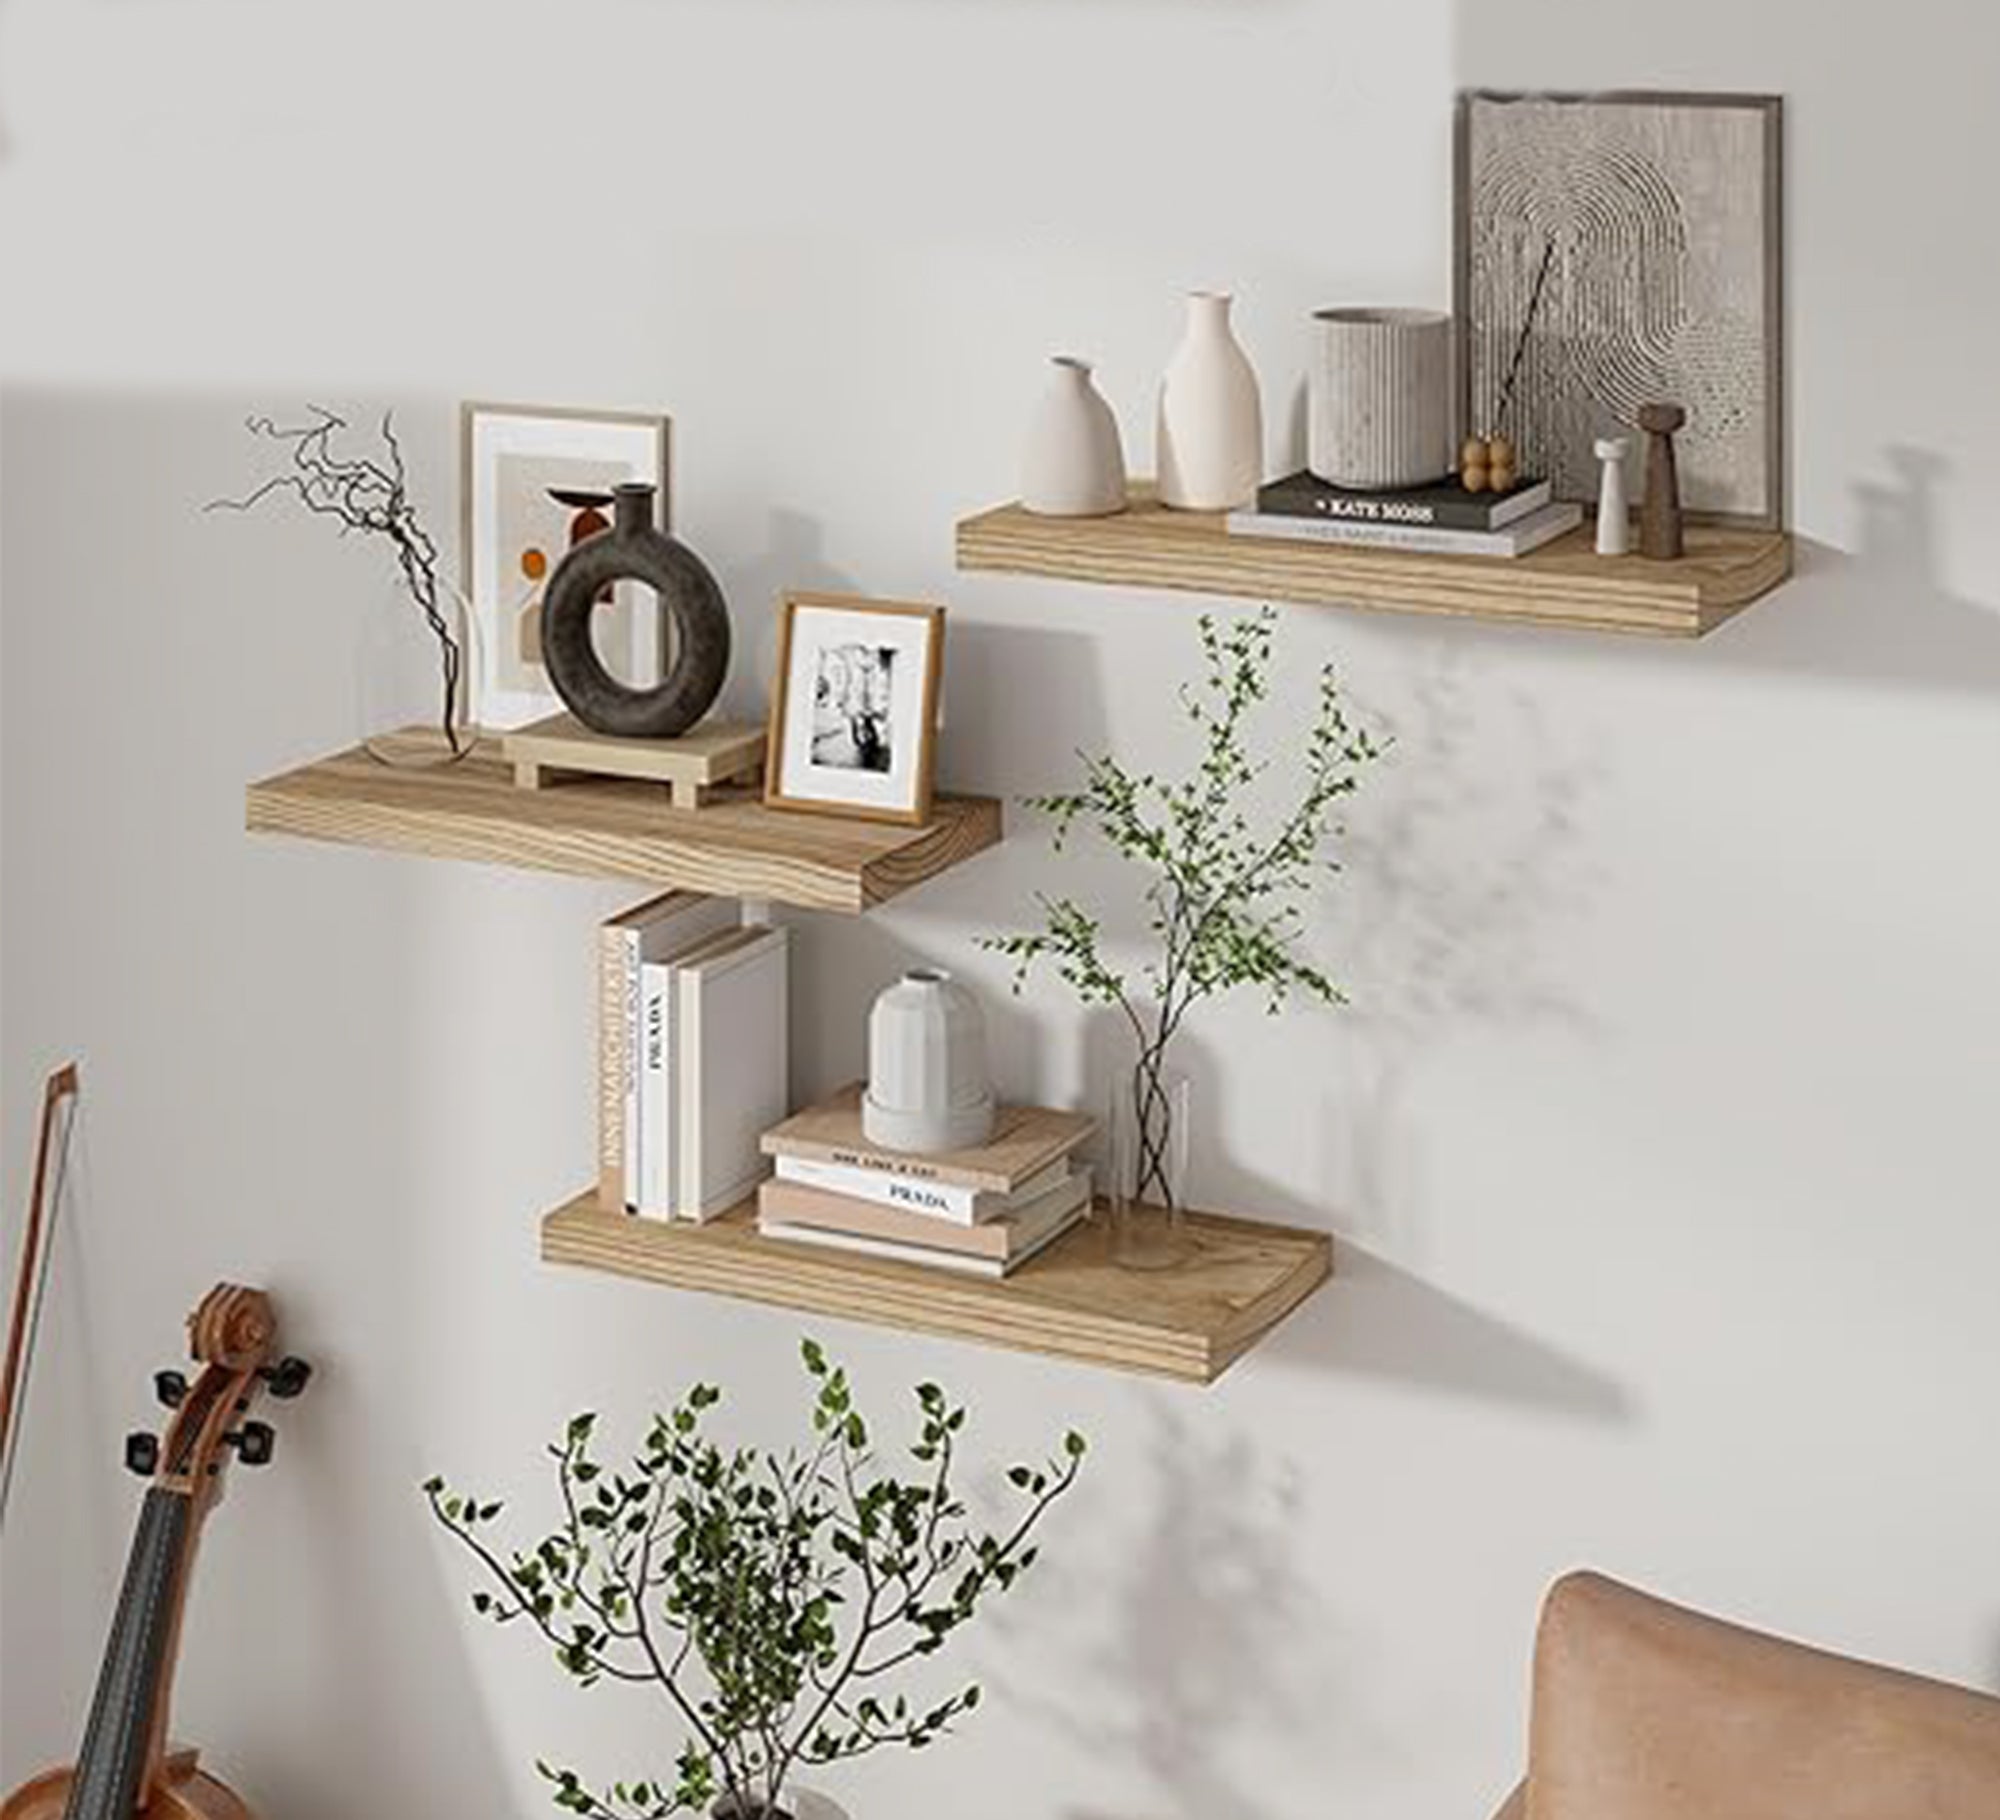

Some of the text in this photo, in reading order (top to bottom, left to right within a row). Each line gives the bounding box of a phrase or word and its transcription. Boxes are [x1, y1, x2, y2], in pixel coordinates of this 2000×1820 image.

[1329, 499, 1379, 519] KATE
[649, 994, 662, 1071] PRADA
[889, 1183, 950, 1212] PRADA
